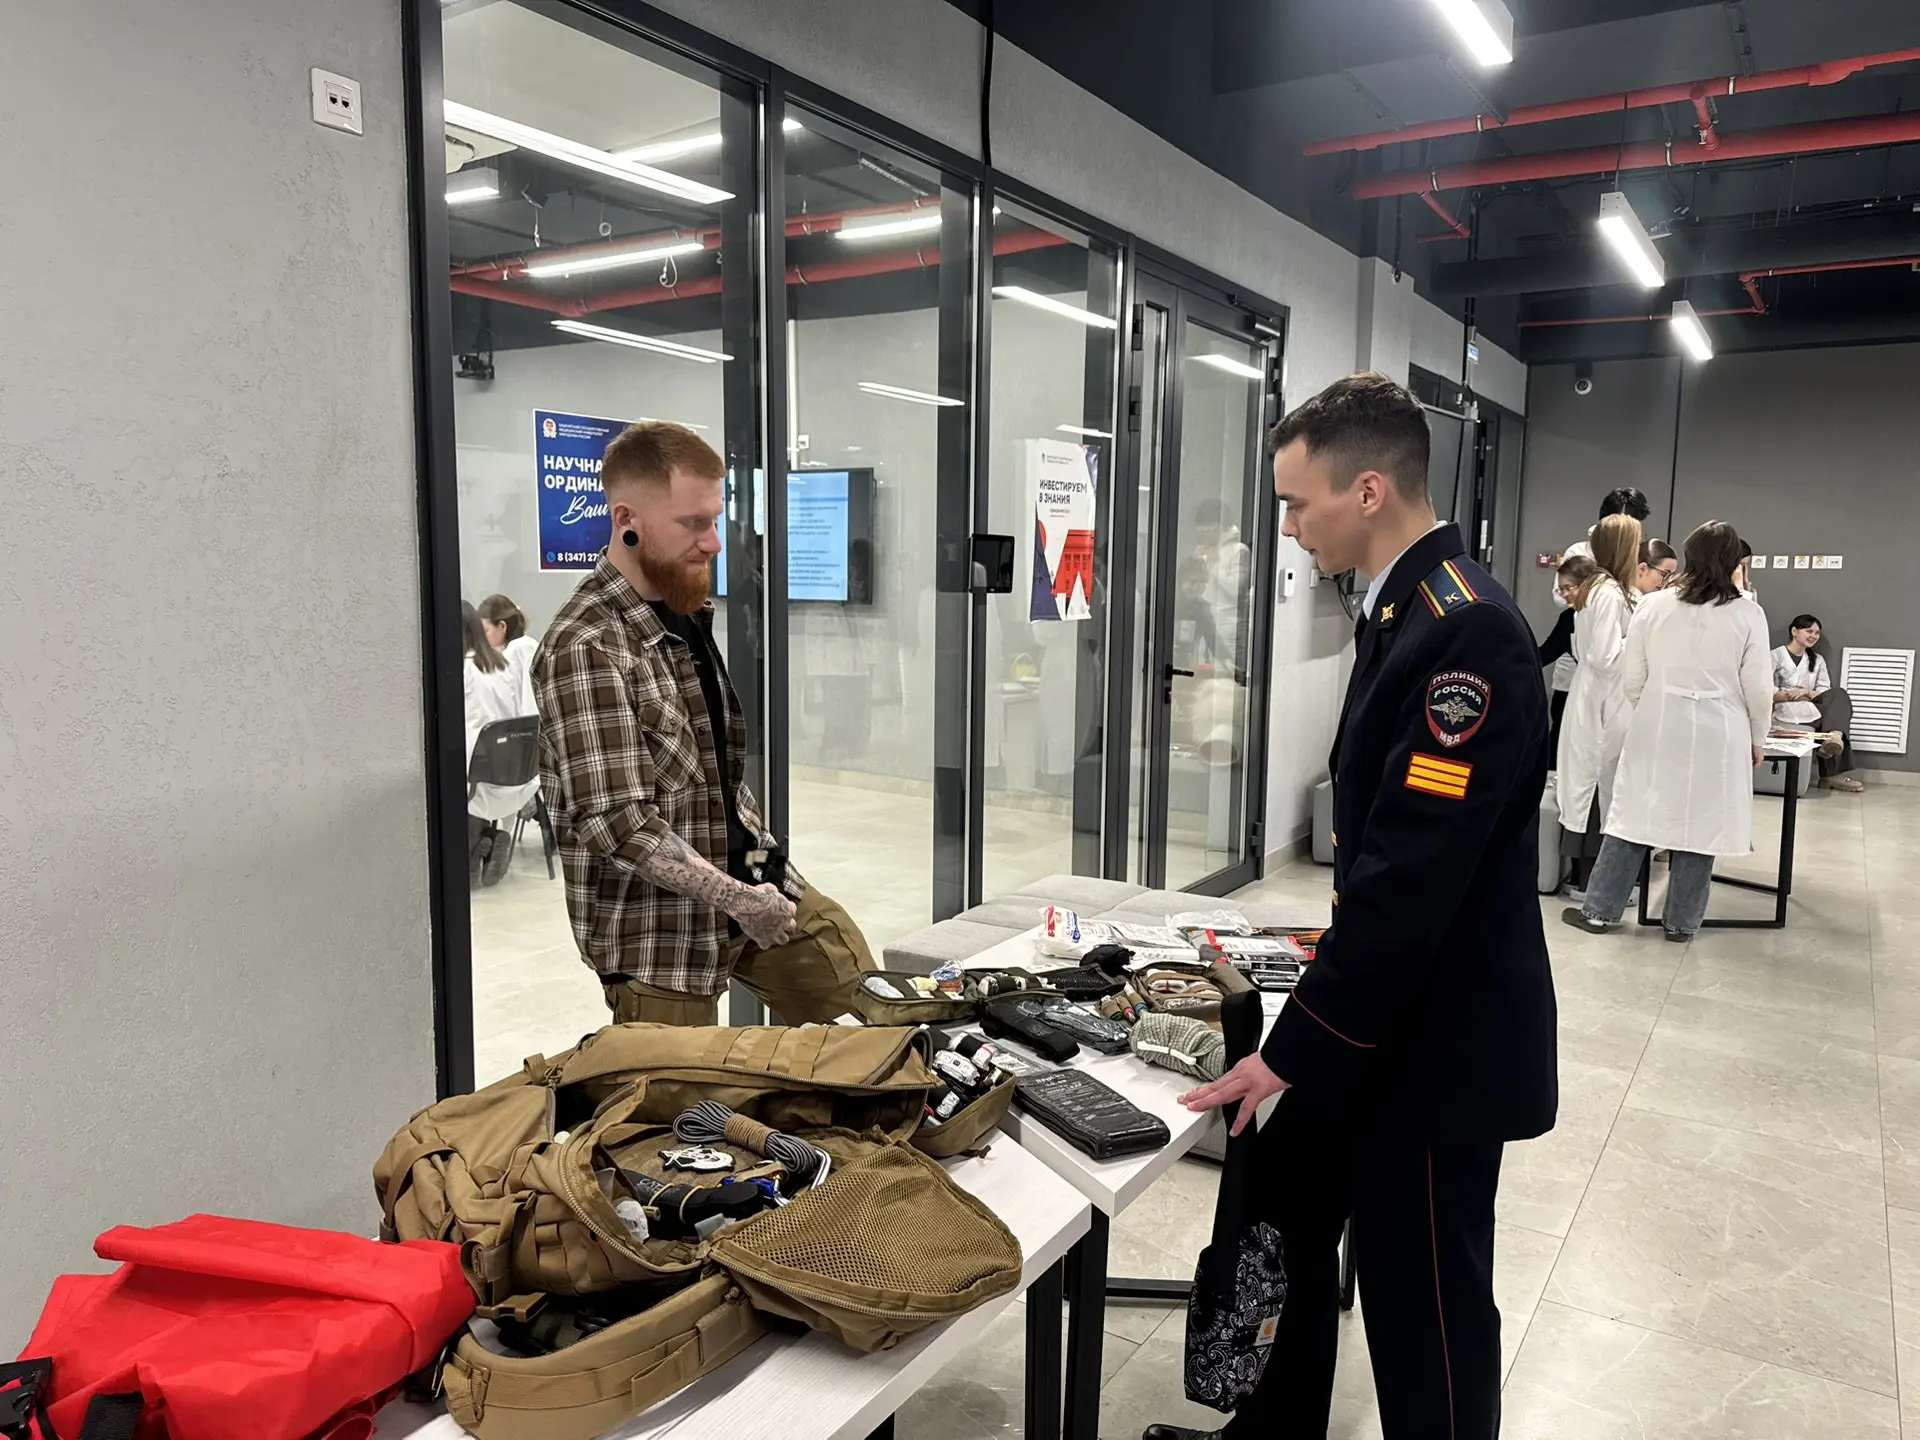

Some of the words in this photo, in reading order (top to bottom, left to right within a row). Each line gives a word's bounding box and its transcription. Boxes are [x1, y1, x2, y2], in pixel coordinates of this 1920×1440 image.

[1039, 479, 1088, 493] ИНВЕСТИРУЕМ
[1039, 492, 1043, 503] В
[1044, 493, 1071, 504] ЗНАНИЯ
[557, 552, 564, 562] 8
[564, 551, 586, 563] (347)
[1432, 671, 1489, 694] ПОЛИЦИЯ
[1433, 684, 1482, 705] РОССИЯ
[1439, 730, 1460, 746] МВД
